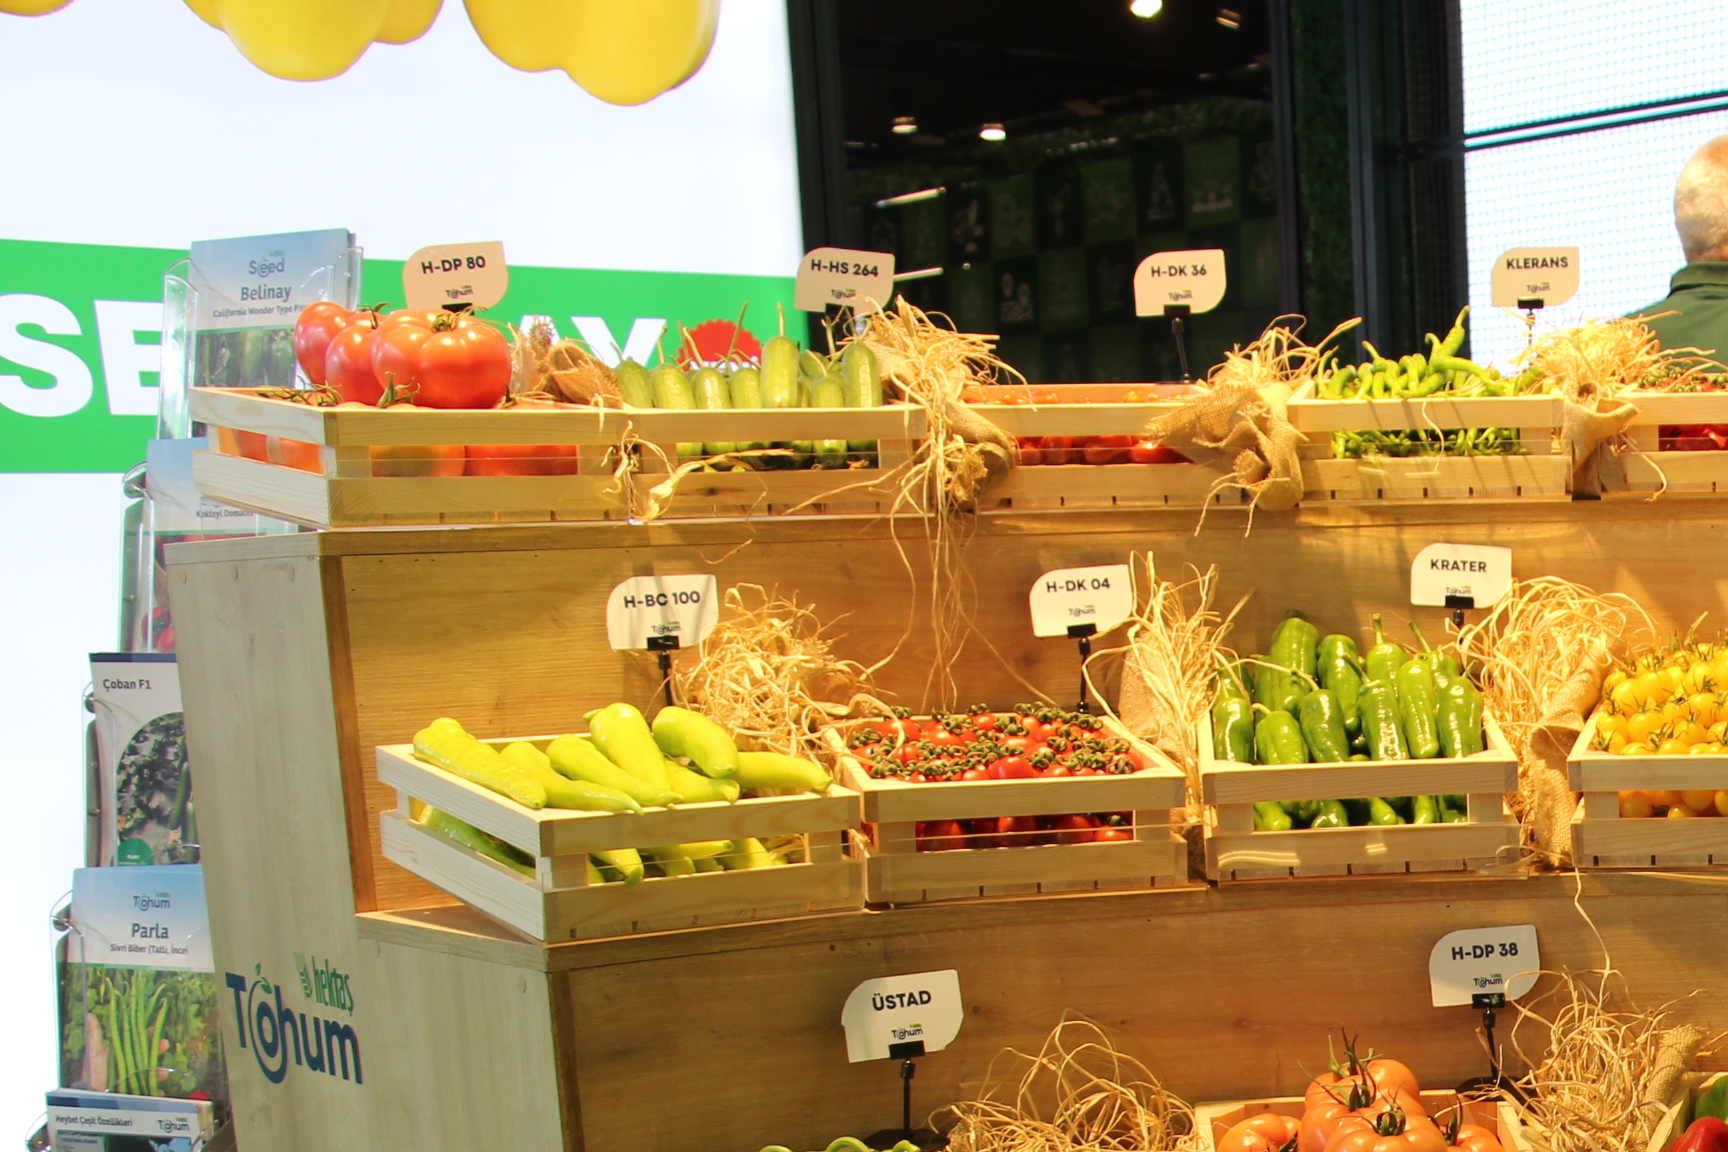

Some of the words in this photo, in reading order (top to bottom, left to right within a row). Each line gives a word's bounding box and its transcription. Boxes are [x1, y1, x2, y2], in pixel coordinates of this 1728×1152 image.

[421, 258, 463, 274] H-DP
[466, 255, 487, 270] 80
[811, 259, 849, 274] H-HS
[852, 263, 879, 277] 264
[1151, 265, 1188, 278] H-DK
[1191, 264, 1207, 276] 36
[1506, 256, 1569, 270] KLERANS
[241, 284, 292, 302] Belinay
[213, 306, 247, 318] California
[249, 305, 275, 315] Wonder
[276, 304, 293, 316] Type
[1430, 558, 1487, 573] KRATER
[1046, 579, 1087, 593] H-DK
[1091, 578, 1110, 590] 04
[623, 593, 668, 608] H-BC
[671, 590, 701, 605] 100
[103, 679, 136, 692] Çoban
[139, 680, 152, 689] F1
[133, 894, 171, 911] Tohum
[131, 923, 169, 939] Parla
[1451, 944, 1495, 960] H-DP
[1498, 942, 1518, 957] 38
[872, 990, 932, 1011] ÜSTAD
[225, 967, 363, 1085] Tohum
